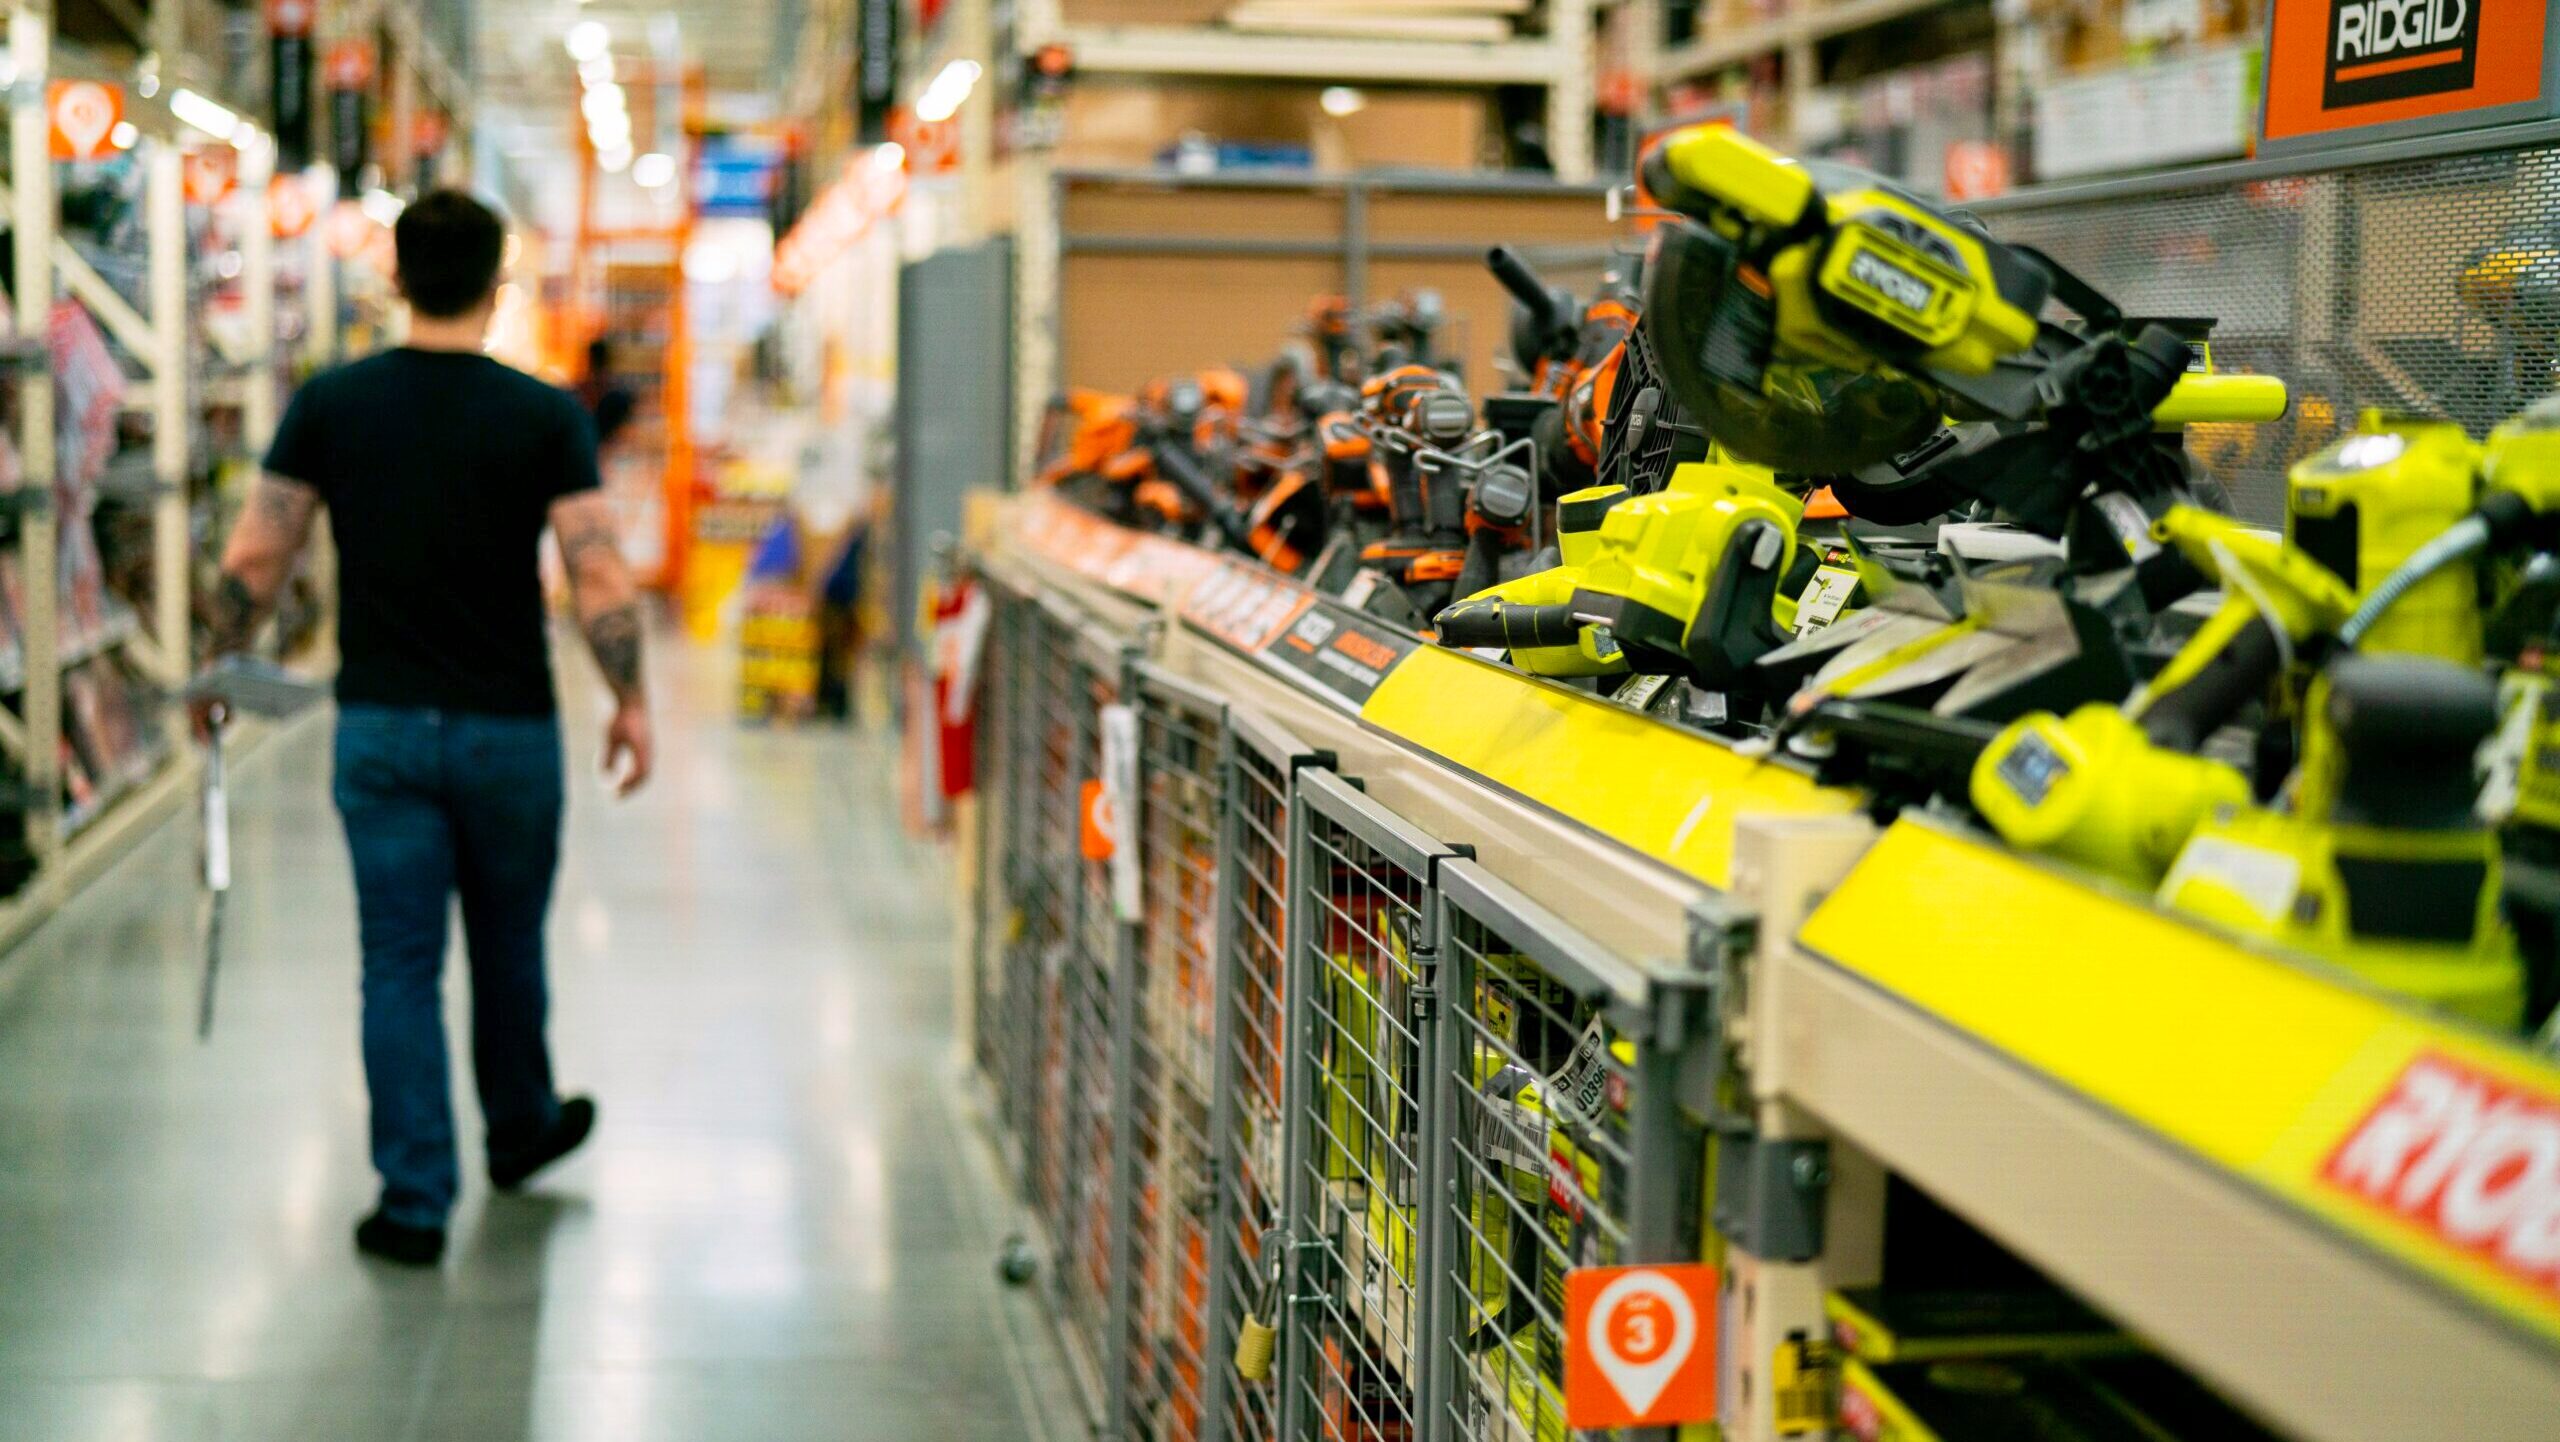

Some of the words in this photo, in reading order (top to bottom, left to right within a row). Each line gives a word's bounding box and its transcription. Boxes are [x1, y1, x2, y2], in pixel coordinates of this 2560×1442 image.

[2336, 0, 2467, 61] RIDGID
[1853, 251, 1932, 311] RYOBI
[1625, 1314, 1656, 1355] 3
